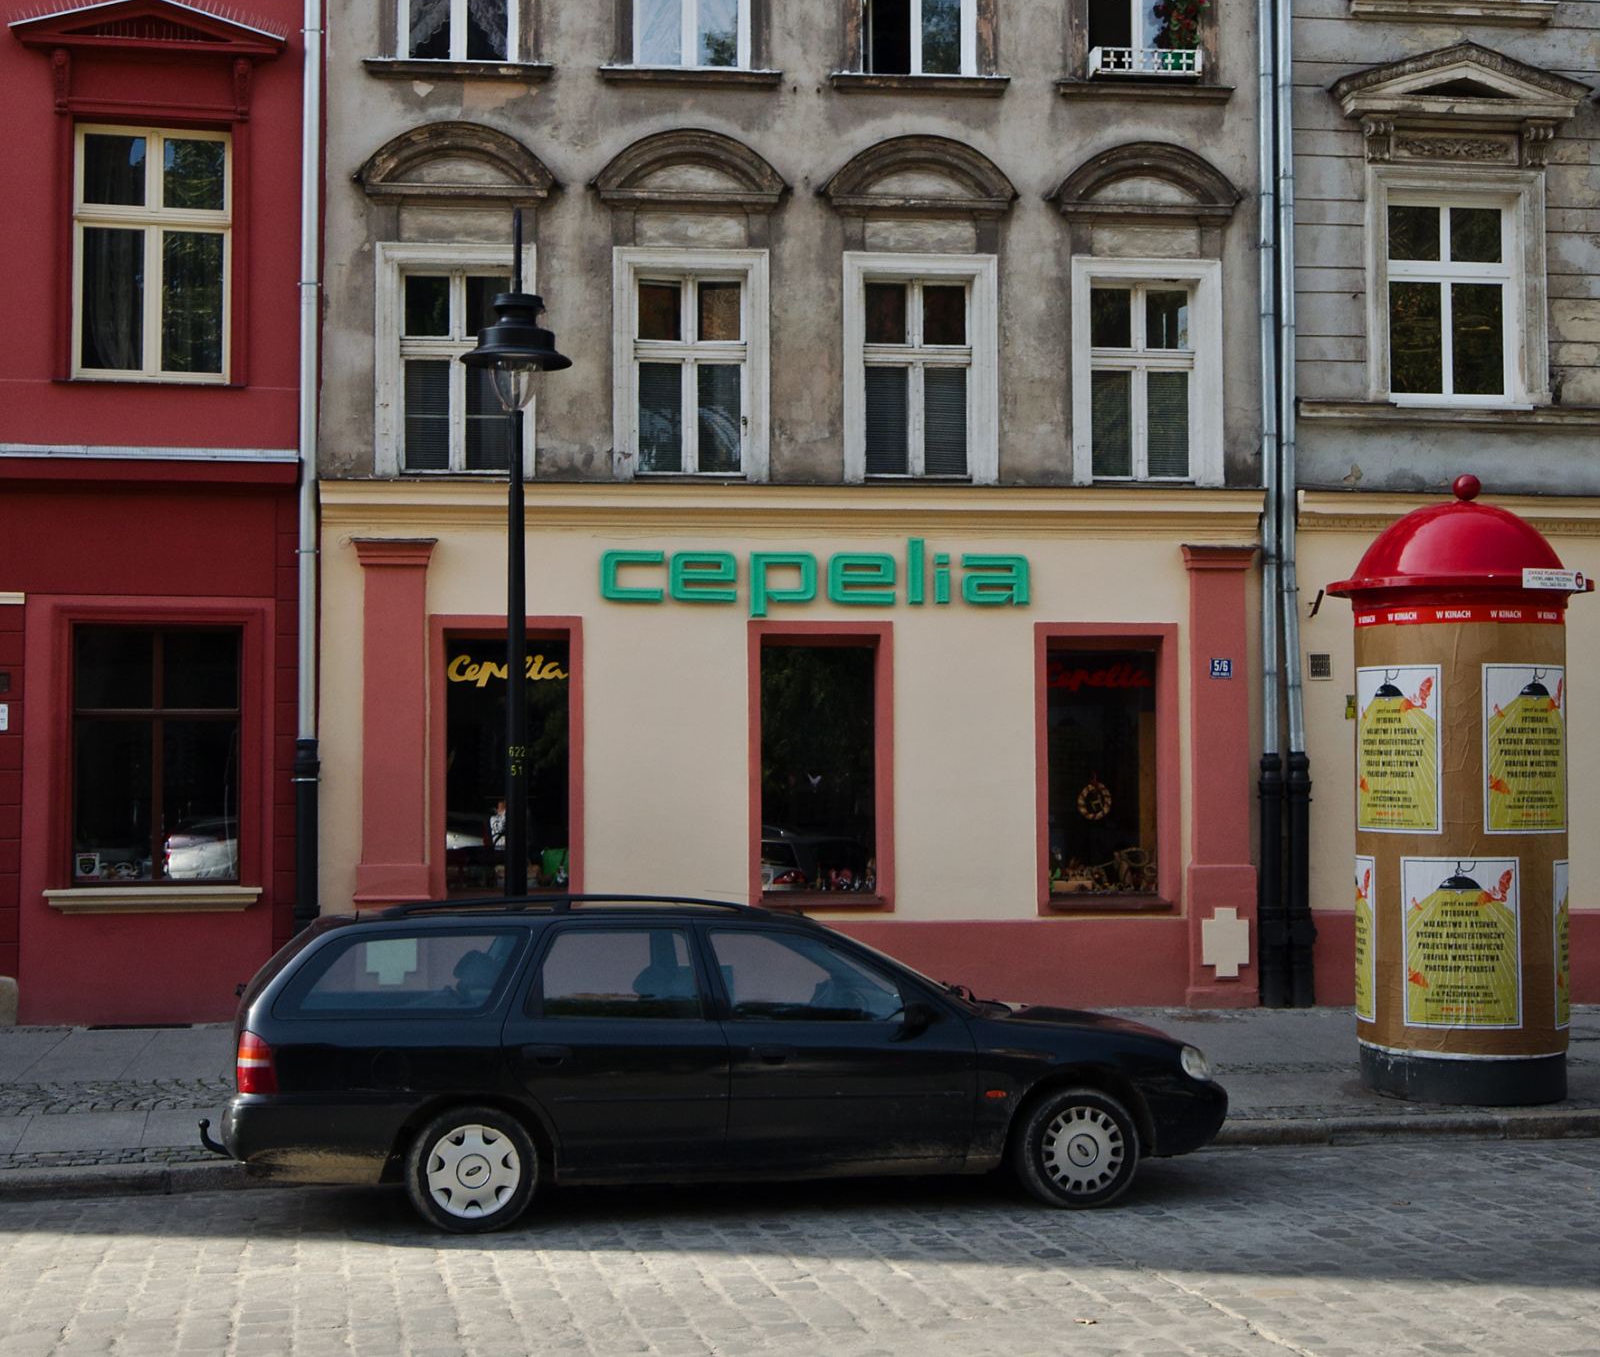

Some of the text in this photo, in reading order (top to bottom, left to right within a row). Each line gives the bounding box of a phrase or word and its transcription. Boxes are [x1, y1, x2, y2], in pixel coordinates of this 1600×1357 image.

[599, 537, 1030, 618] cepelia
[1394, 611, 1417, 621] KINACH
[1436, 610, 1471, 619] W KINACH
[1490, 610, 1522, 619] W KINACH
[1213, 659, 1229, 672] 5/6
[508, 746, 526, 758] 622
